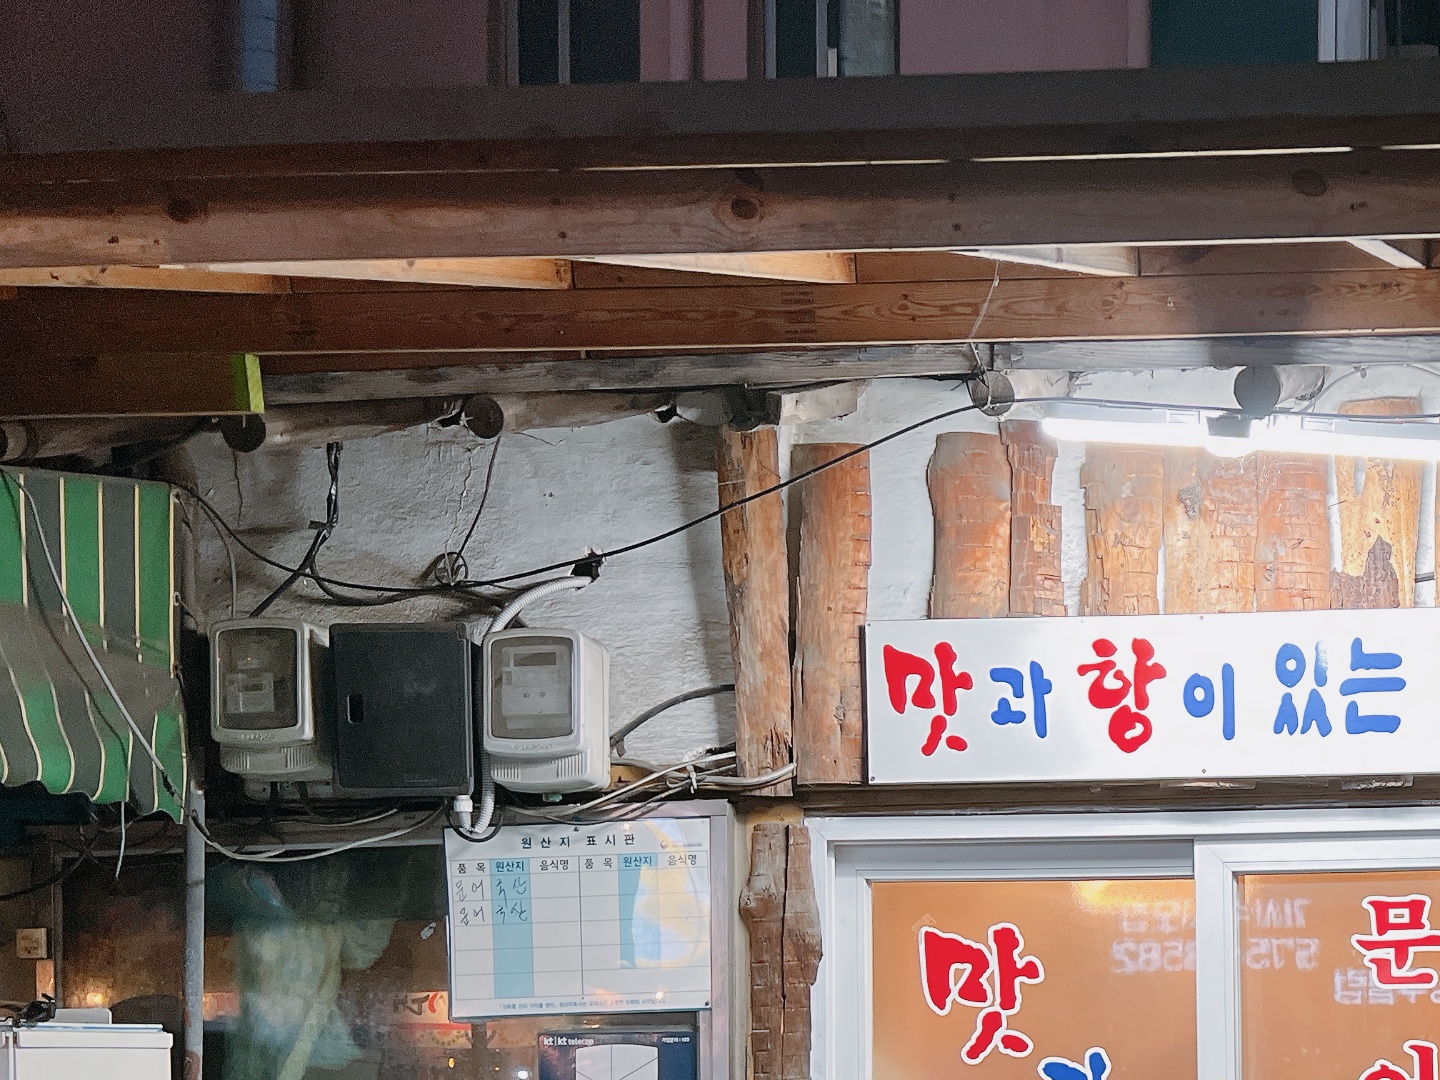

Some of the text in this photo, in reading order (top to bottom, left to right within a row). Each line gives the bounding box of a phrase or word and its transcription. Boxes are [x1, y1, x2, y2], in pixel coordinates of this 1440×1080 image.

[883, 641, 1052, 756] 맛과
[1077, 637, 1235, 754] 향이
[1273, 636, 1406, 738] 있는
[521, 834, 636, 849] 원산지 표시판
[494, 860, 525, 873] 원산지
[539, 859, 570, 871] 음식명
[622, 855, 653, 868] 원산지
[667, 854, 698, 866] 음식명
[543, 1037, 554, 1046] kt
[557, 1036, 568, 1046] kt
